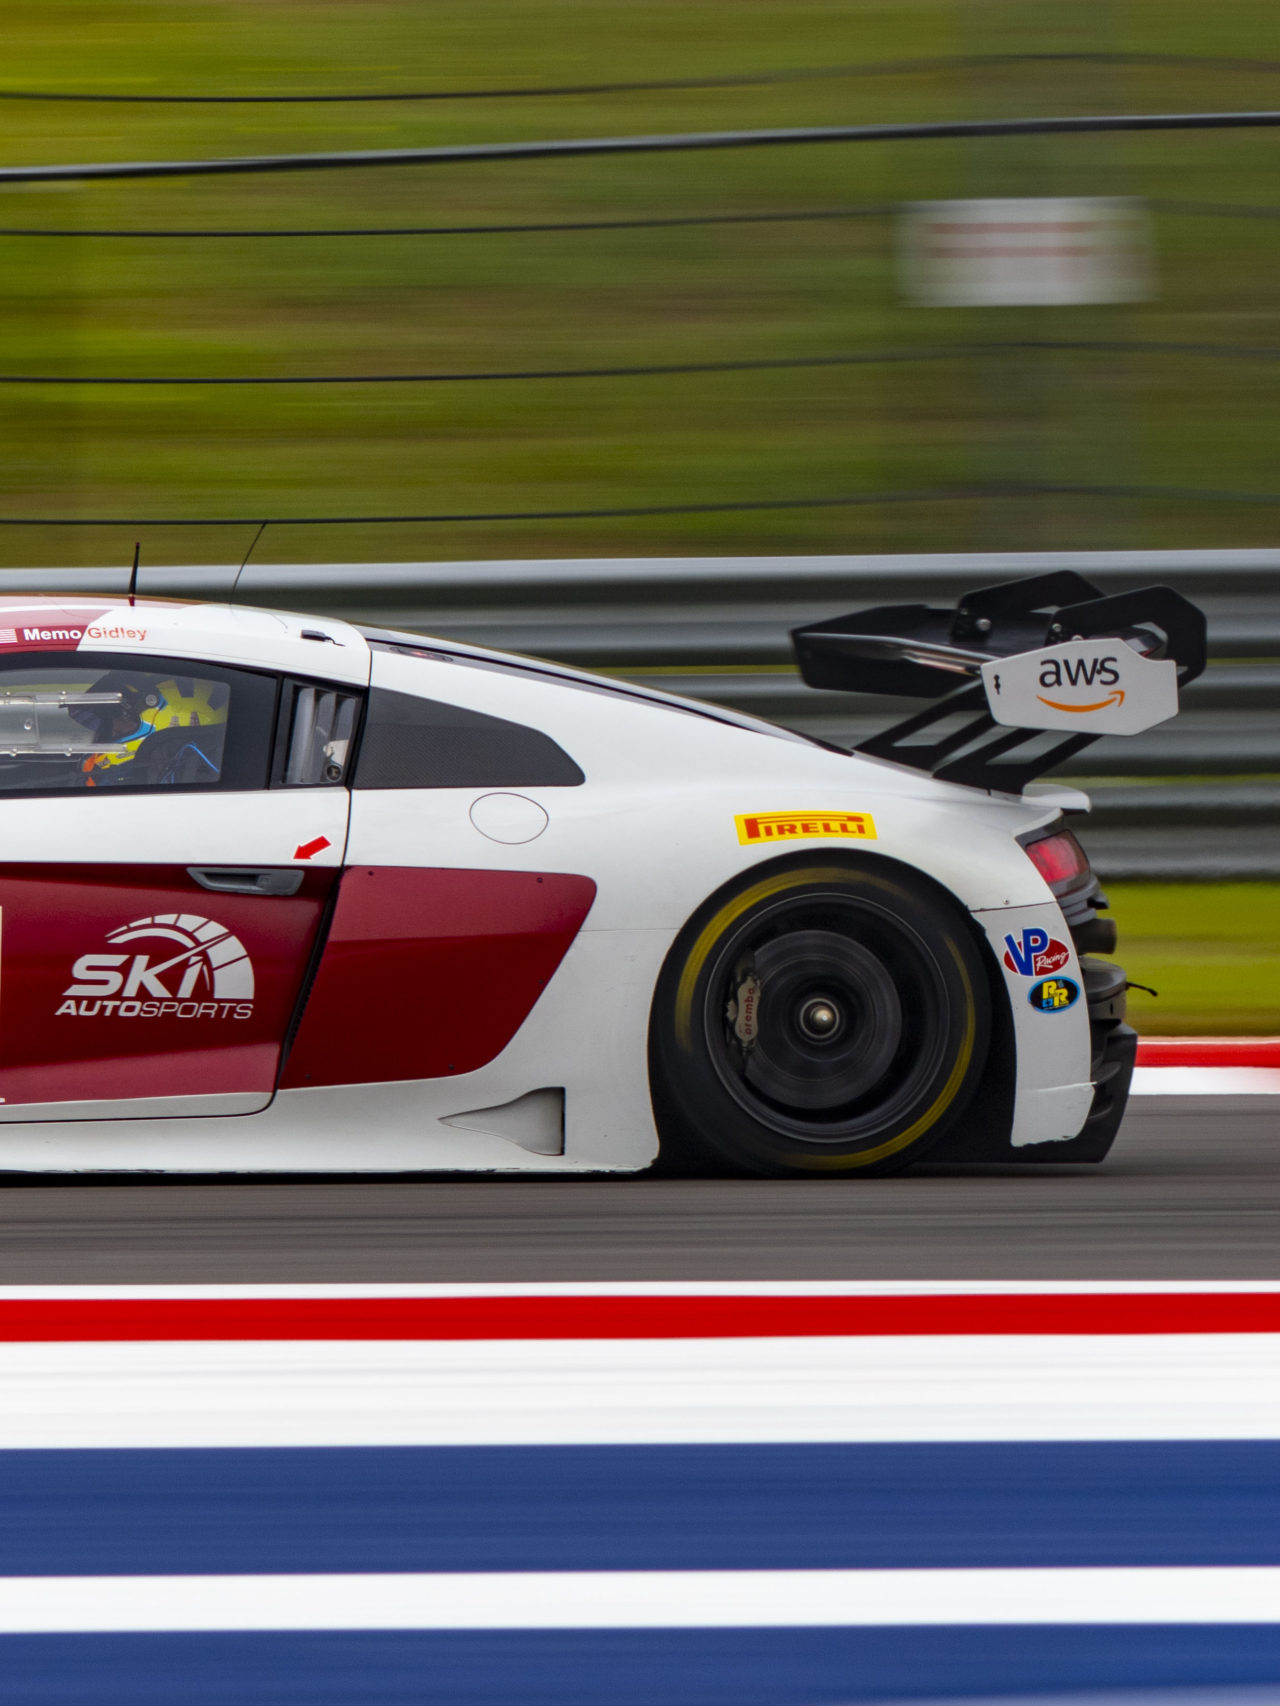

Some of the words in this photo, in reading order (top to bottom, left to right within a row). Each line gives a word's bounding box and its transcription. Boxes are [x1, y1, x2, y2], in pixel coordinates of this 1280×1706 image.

[23, 628, 81, 640] Memo
[87, 627, 147, 641] Gidley
[1039, 656, 1120, 688] aws
[744, 814, 866, 839] PIRELLI
[1003, 927, 1049, 977] VP
[1035, 951, 1070, 972] Racing
[54, 999, 255, 1020] AUTOSPORTS
